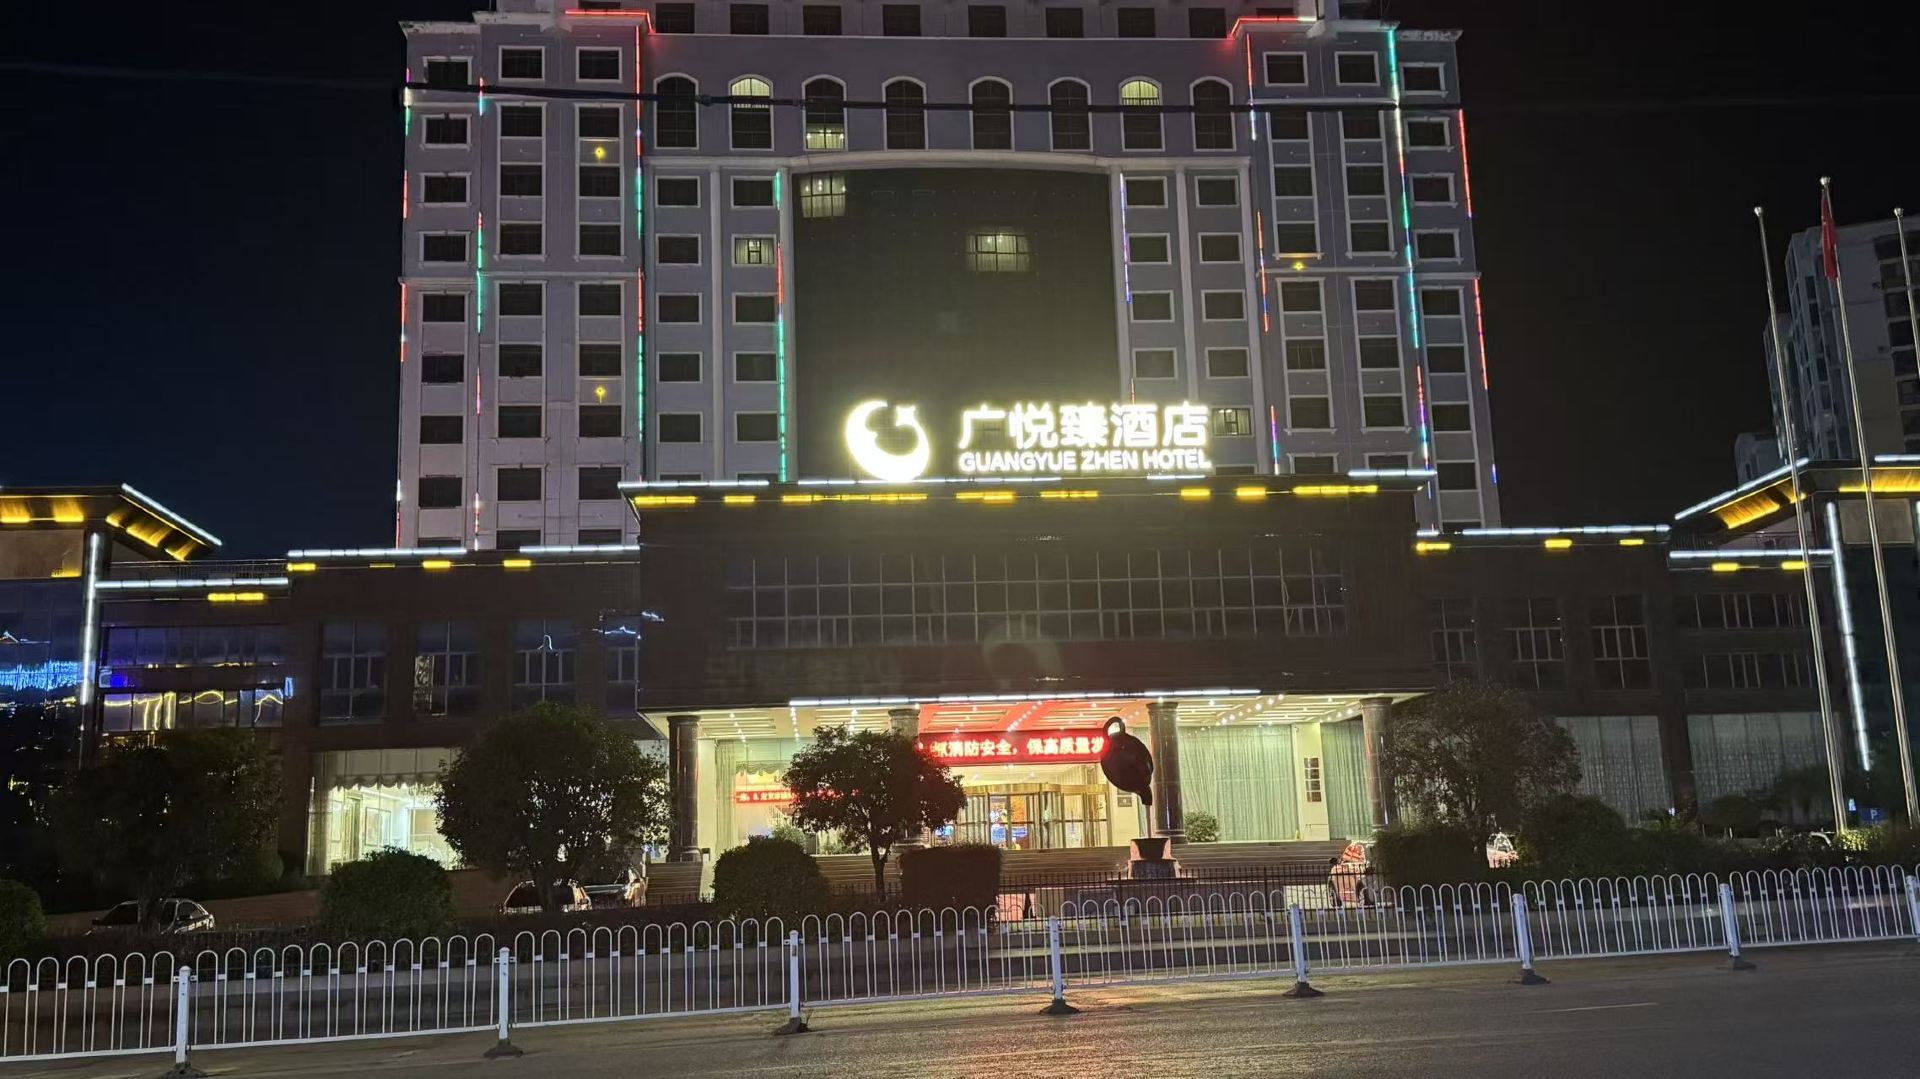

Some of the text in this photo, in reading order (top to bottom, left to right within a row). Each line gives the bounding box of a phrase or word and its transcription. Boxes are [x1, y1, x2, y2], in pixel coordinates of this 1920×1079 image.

[959, 402, 1208, 448] 广悦臻酒店
[959, 448, 1211, 472] GUANGYUE ZHEN HOTEL
[1870, 809, 1878, 820] P
